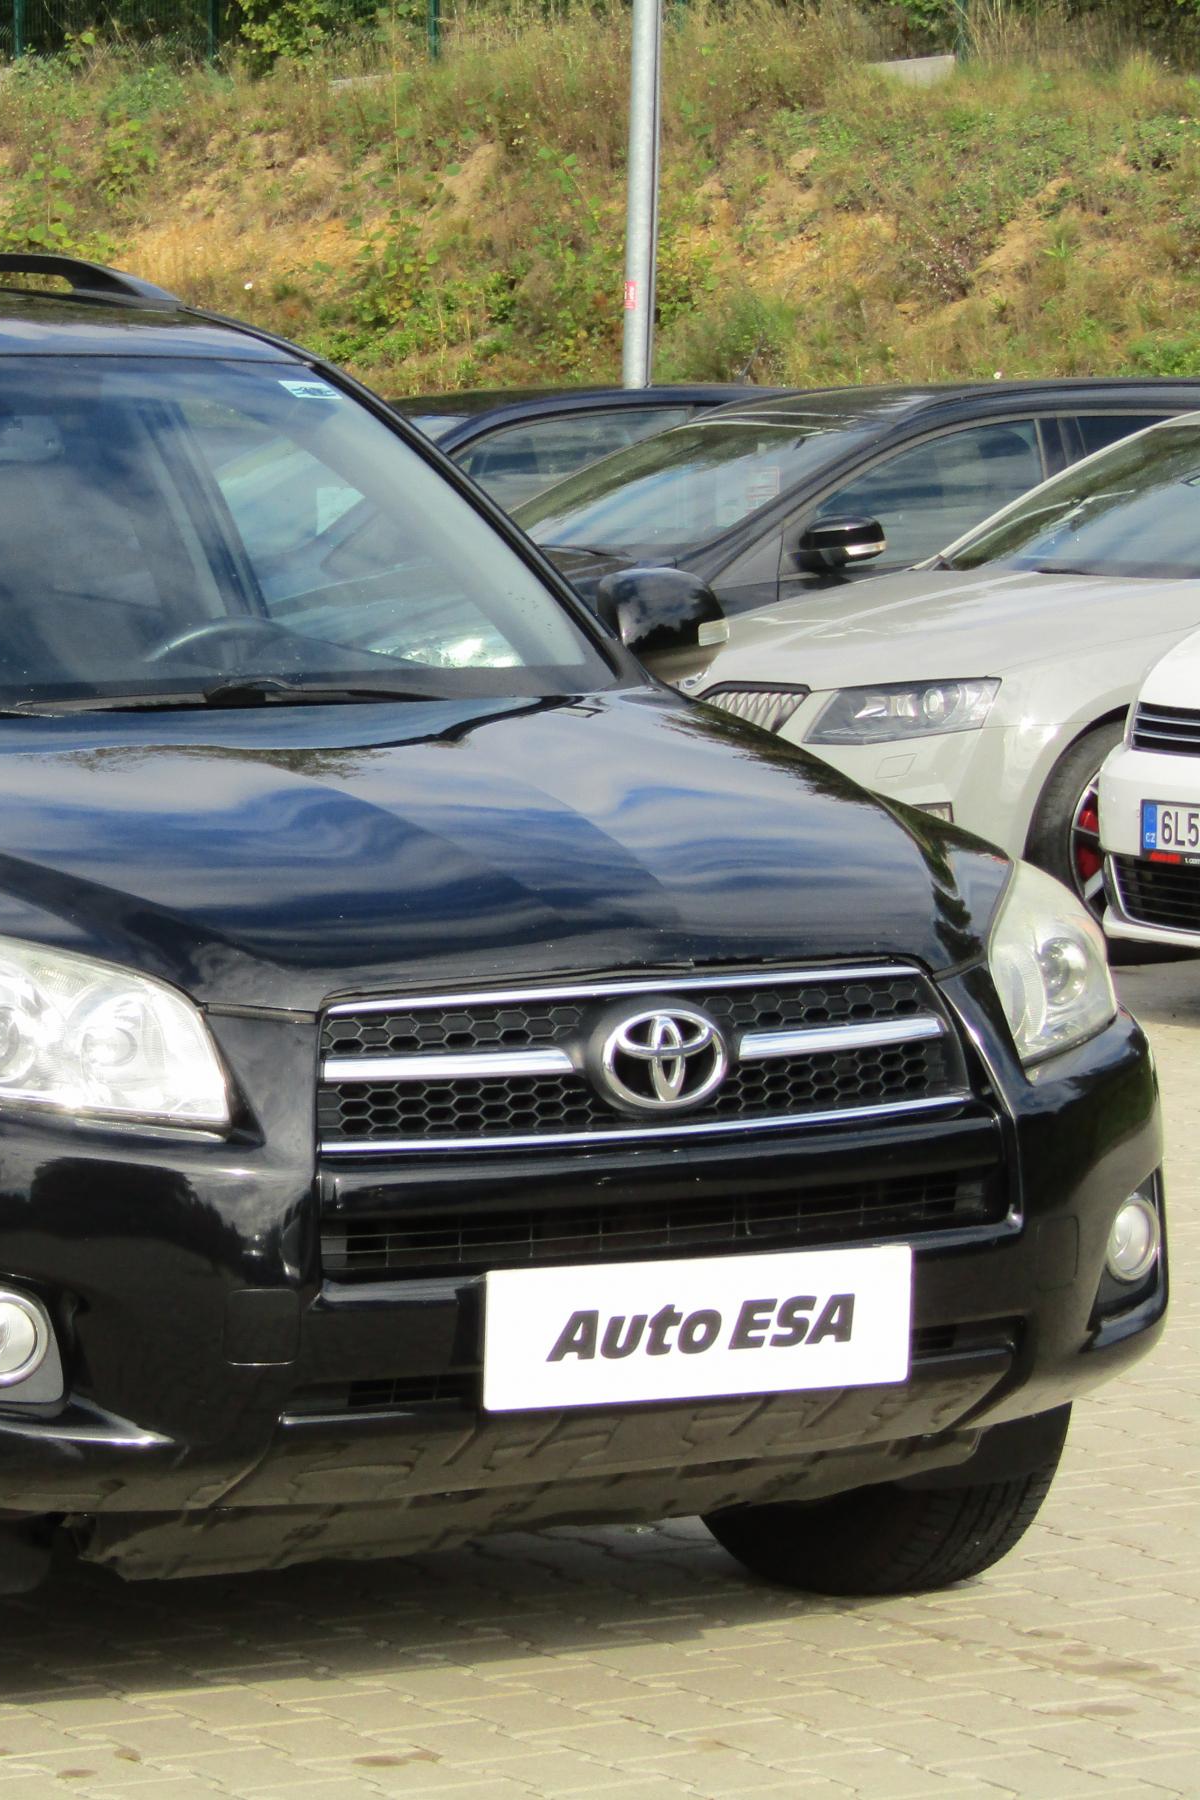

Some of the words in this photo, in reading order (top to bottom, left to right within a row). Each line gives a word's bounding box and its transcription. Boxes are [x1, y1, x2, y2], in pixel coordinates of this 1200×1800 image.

[1145, 832, 1156, 843] CZ
[1161, 810, 1200, 848] 6L5
[545, 1303, 722, 1362] Auto
[727, 1293, 856, 1350] ESA
